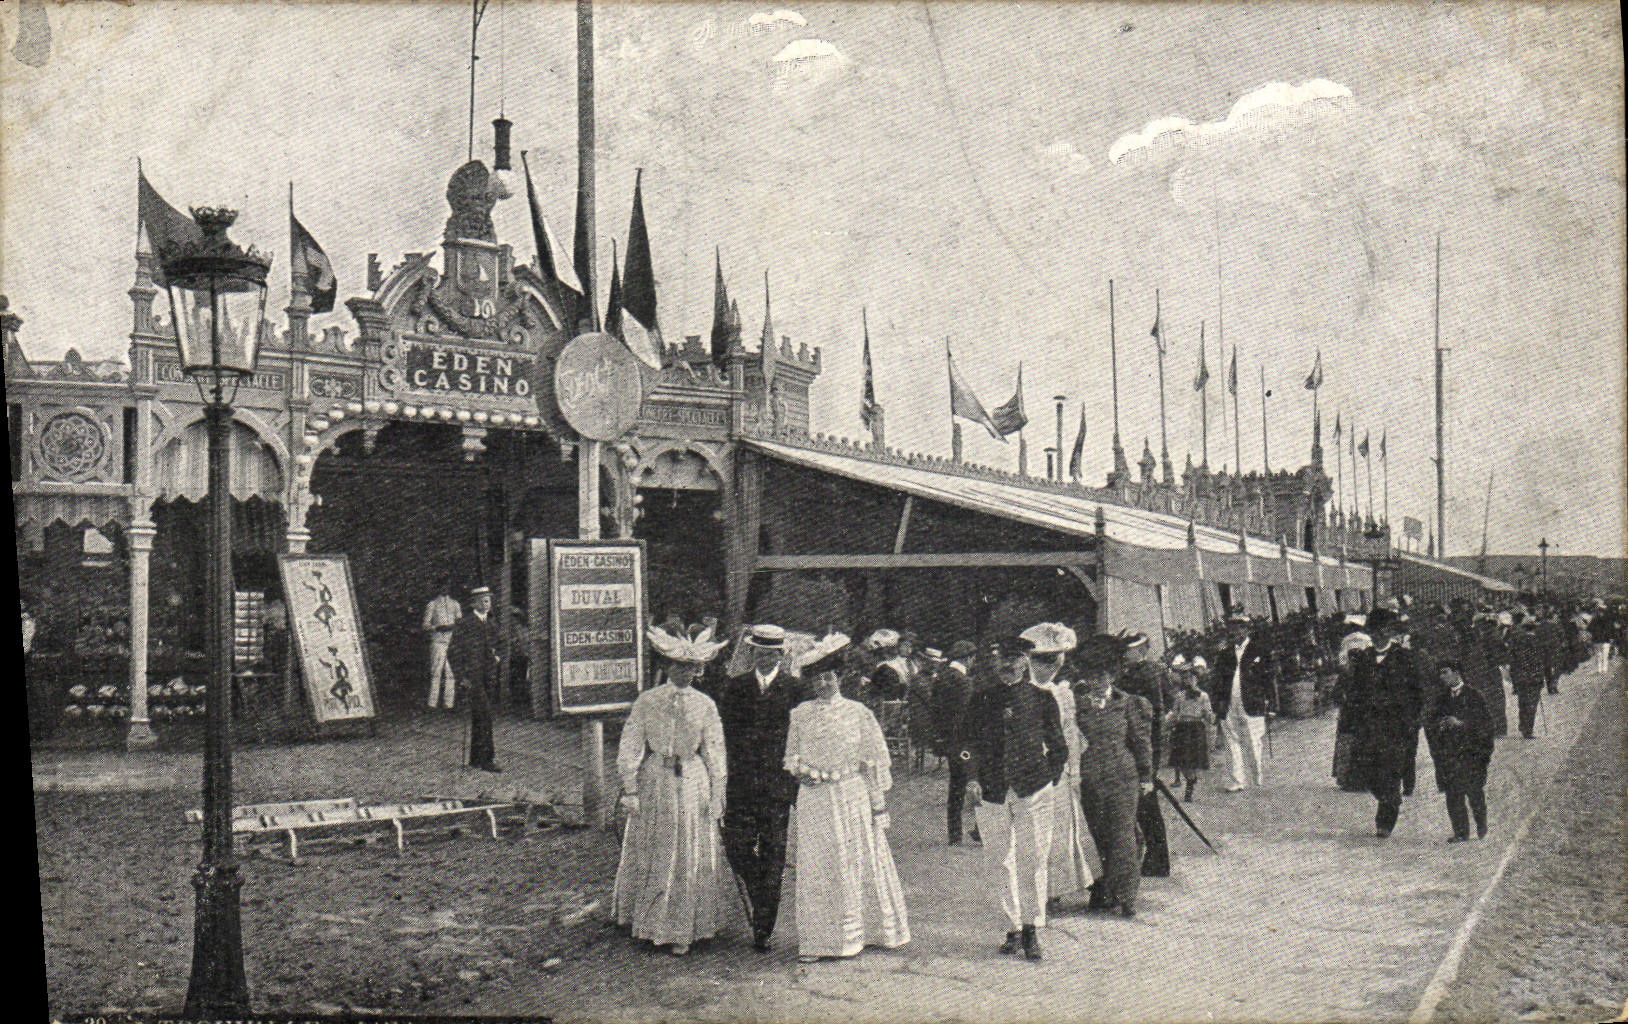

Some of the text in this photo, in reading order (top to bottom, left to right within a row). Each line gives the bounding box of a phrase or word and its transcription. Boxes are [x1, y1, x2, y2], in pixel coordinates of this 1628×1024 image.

[432, 351, 513, 376] EDEN
[413, 369, 530, 396] CASINO
[571, 589, 622, 605] DUVAL
